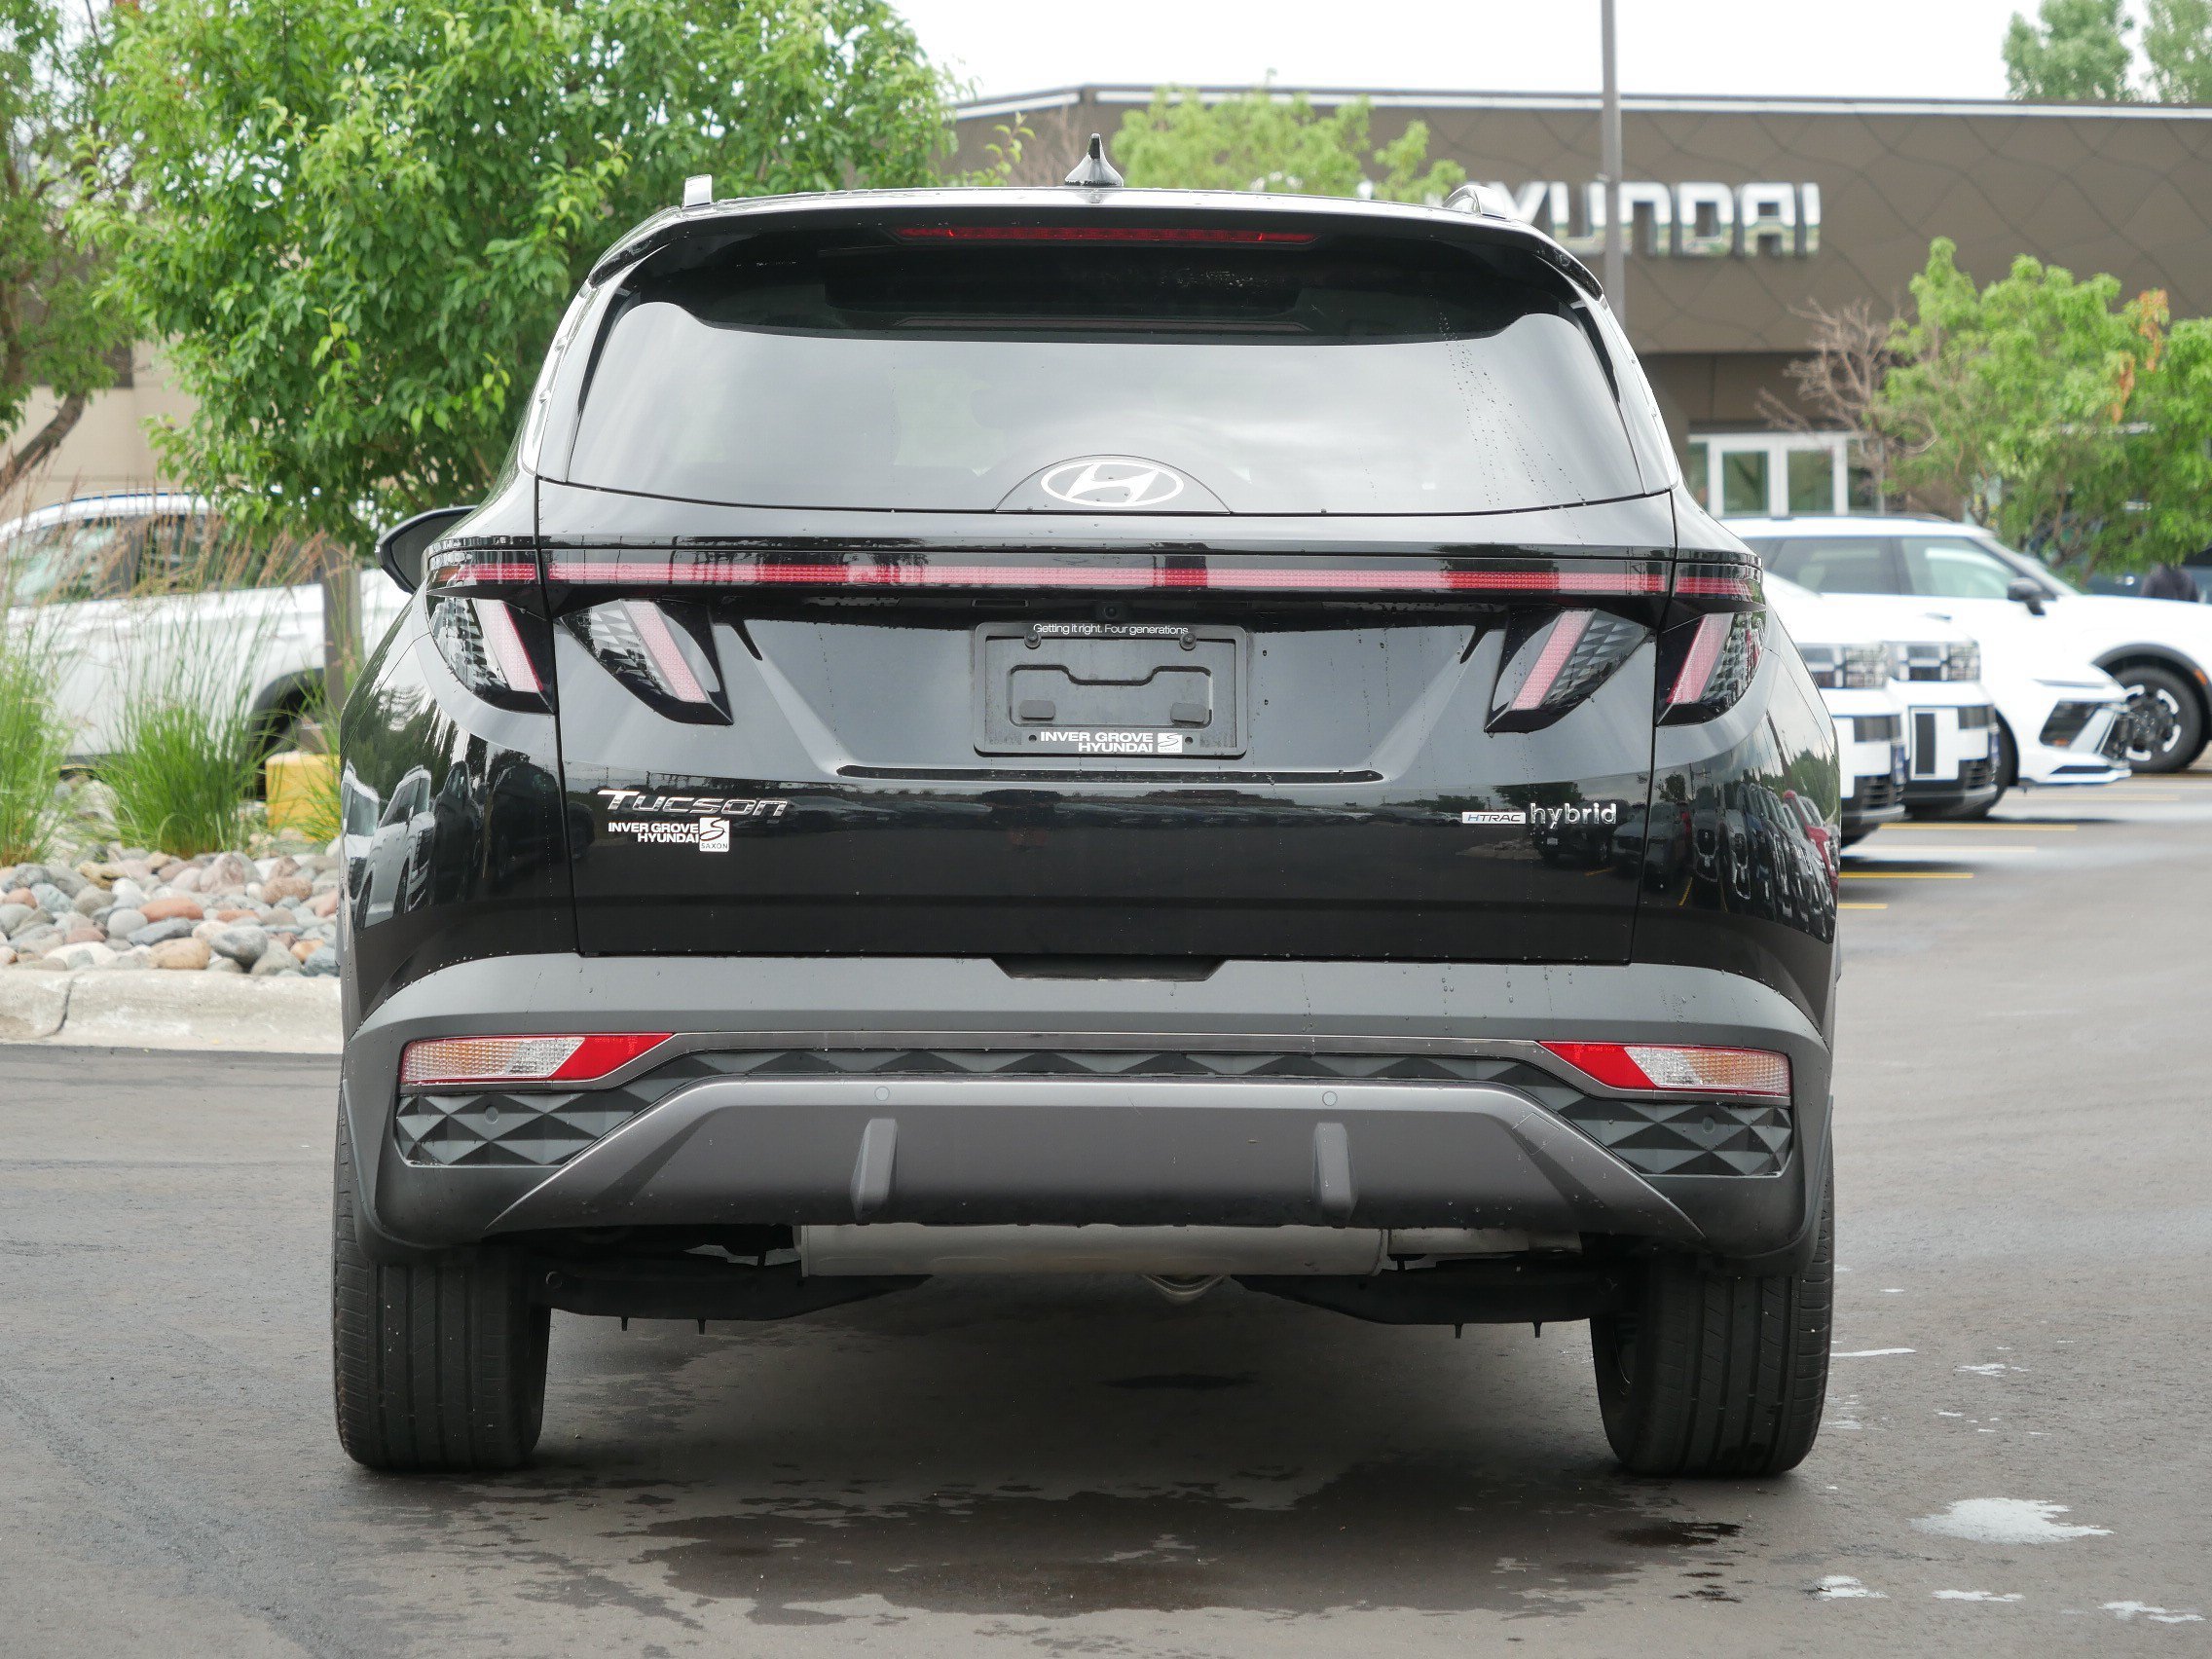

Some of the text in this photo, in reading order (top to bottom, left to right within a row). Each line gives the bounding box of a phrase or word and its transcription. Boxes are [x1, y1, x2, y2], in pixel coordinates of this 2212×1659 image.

[1033, 623, 1189, 635] Getting it right. Four generations
[1040, 731, 1154, 743] INVER GROVE
[1078, 742, 1154, 753] HYUNDAI
[1467, 802, 1617, 830] HTRAC hybrid
[608, 822, 700, 833] INVER GROVE
[637, 832, 700, 844] HYUNDAI
[700, 841, 729, 850] SAXON
